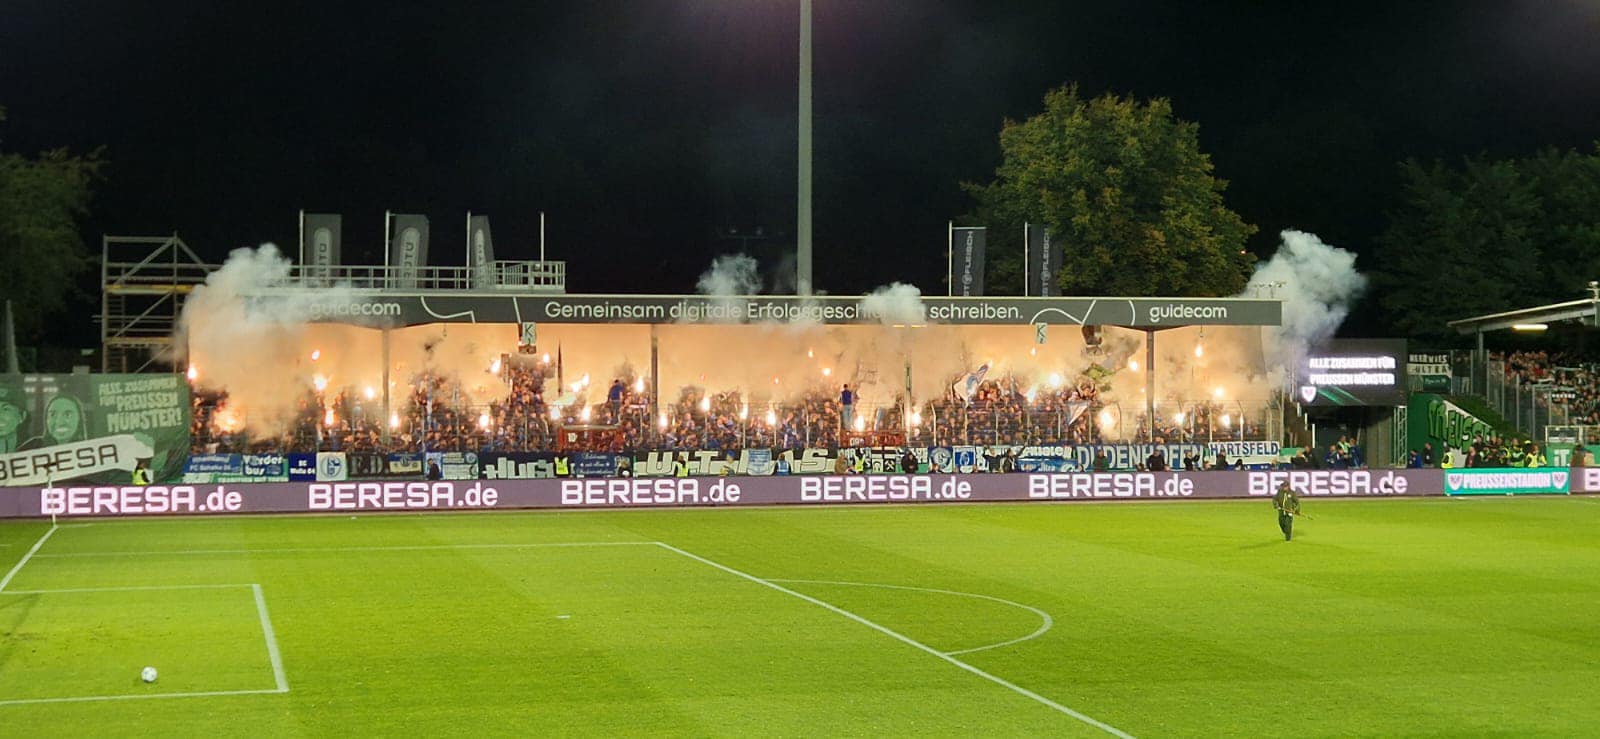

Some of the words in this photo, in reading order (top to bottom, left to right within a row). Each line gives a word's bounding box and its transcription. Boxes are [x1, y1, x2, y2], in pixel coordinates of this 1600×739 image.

[544, 302, 666, 319] Gemeinsam
[669, 300, 742, 321] digitale
[929, 302, 1023, 319] schreiben.
[1149, 303, 1228, 322] guidecom
[107, 407, 183, 433] MÜNSTER!
[1209, 442, 1279, 456] HARTSFELD
[308, 480, 498, 509] BERESA.de
[561, 478, 741, 504] BERESA.de
[800, 475, 972, 501] BERESA.de
[1029, 473, 1194, 497] BERESA.de
[1249, 471, 1408, 495] BERESA.de
[41, 485, 242, 515] BERESA.de
